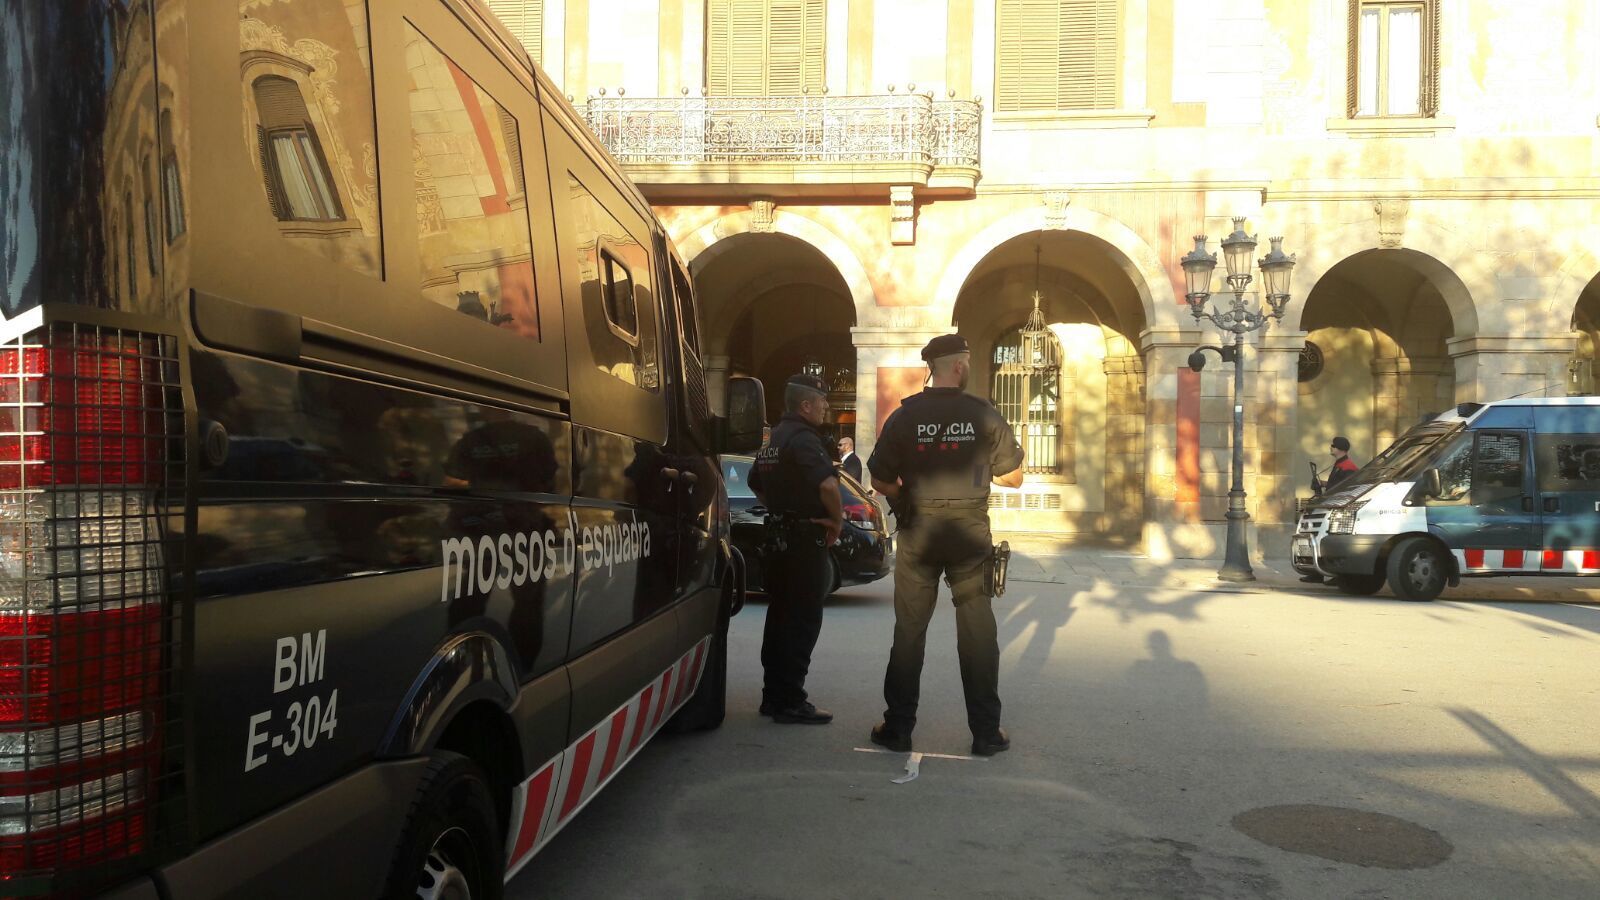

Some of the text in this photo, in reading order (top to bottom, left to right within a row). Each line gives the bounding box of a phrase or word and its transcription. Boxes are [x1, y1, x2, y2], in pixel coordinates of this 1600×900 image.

[441, 509, 651, 602] mossos d'esquadra
[273, 629, 327, 694] BM
[245, 688, 338, 773] E-304
